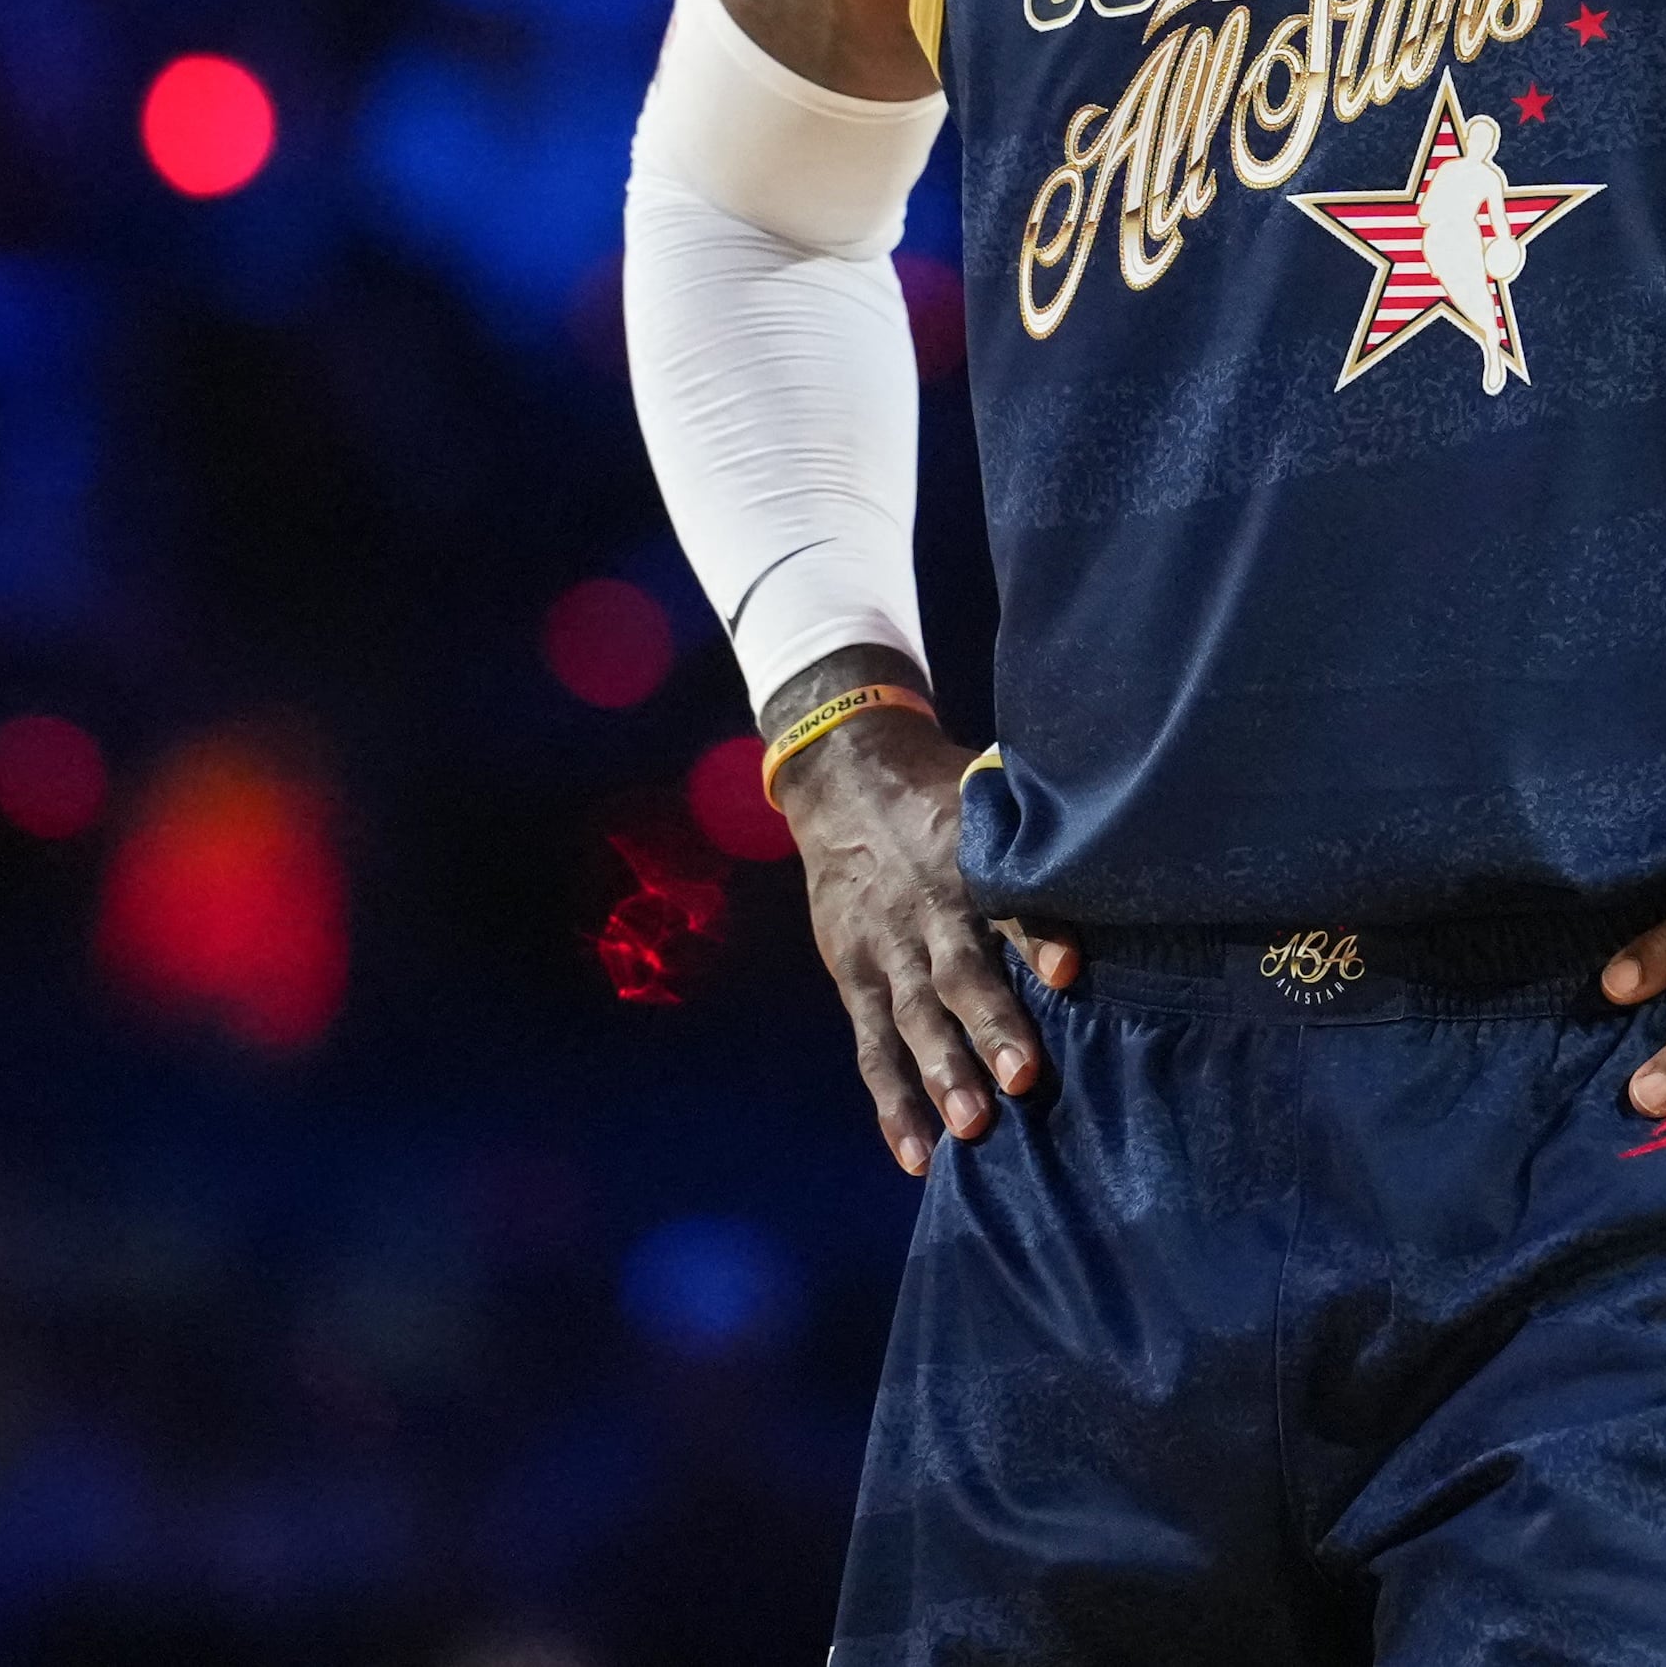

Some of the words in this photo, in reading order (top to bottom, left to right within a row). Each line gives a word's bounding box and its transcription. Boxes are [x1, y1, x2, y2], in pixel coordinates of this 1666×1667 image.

[1019, 7, 1250, 340] All
[873, 688, 882, 702] I
[1260, 930, 1365, 984] NBA
